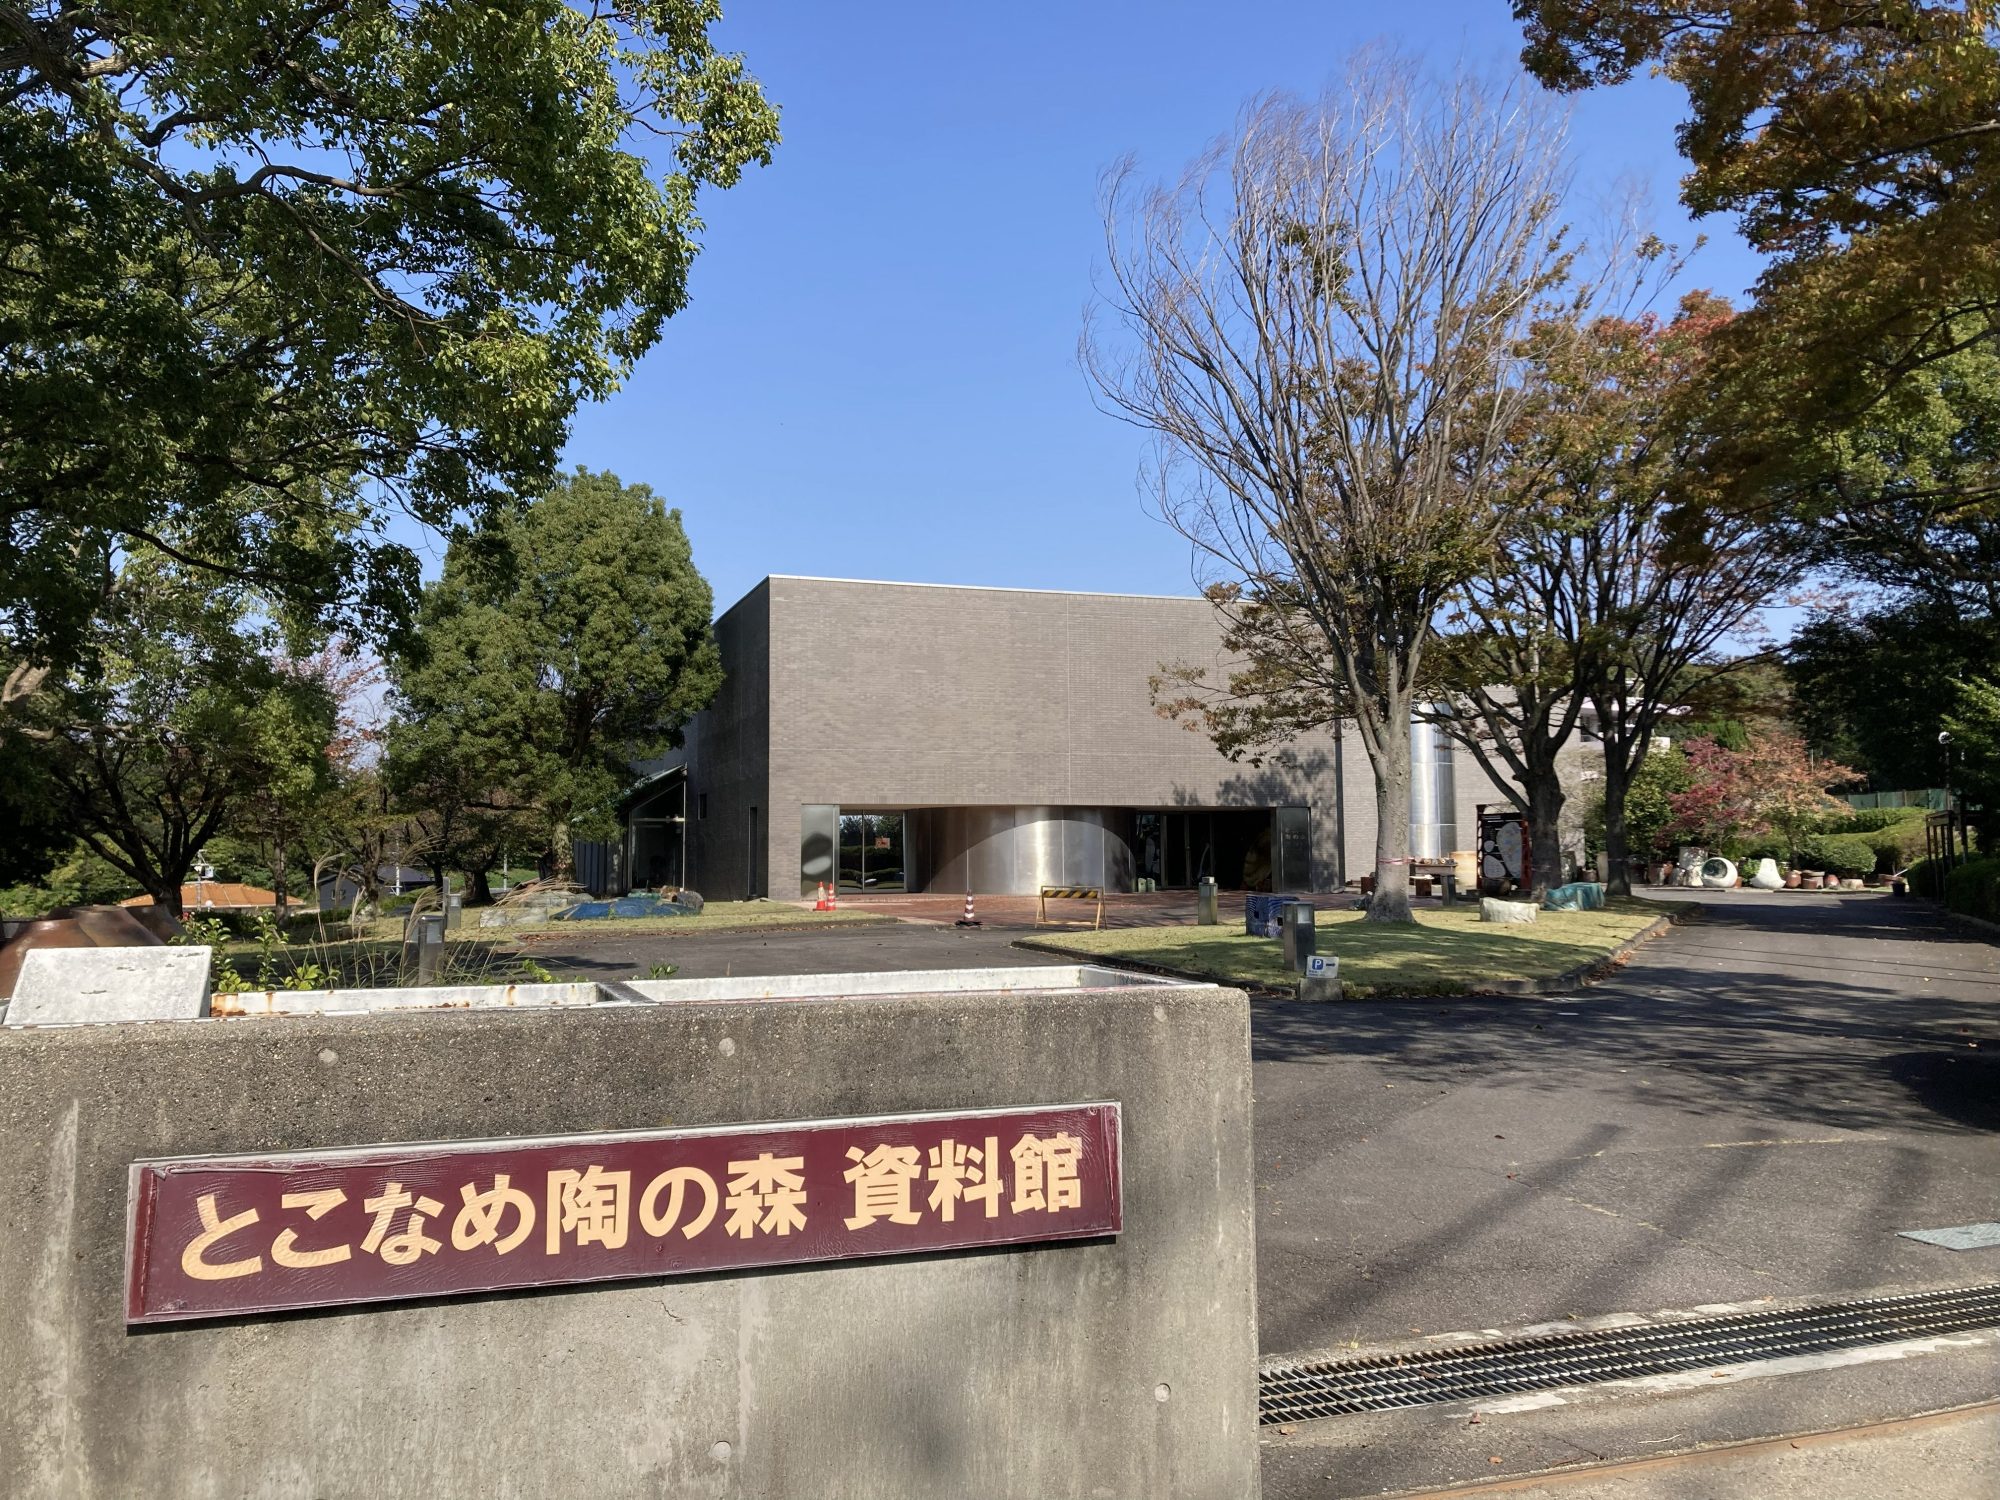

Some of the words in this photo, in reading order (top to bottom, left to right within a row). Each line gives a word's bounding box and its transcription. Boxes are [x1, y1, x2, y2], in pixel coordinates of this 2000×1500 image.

[1314, 959, 1322, 970] P
[180, 1152, 808, 1281] とこなめ陶の森
[842, 1131, 1084, 1231] 資料館
